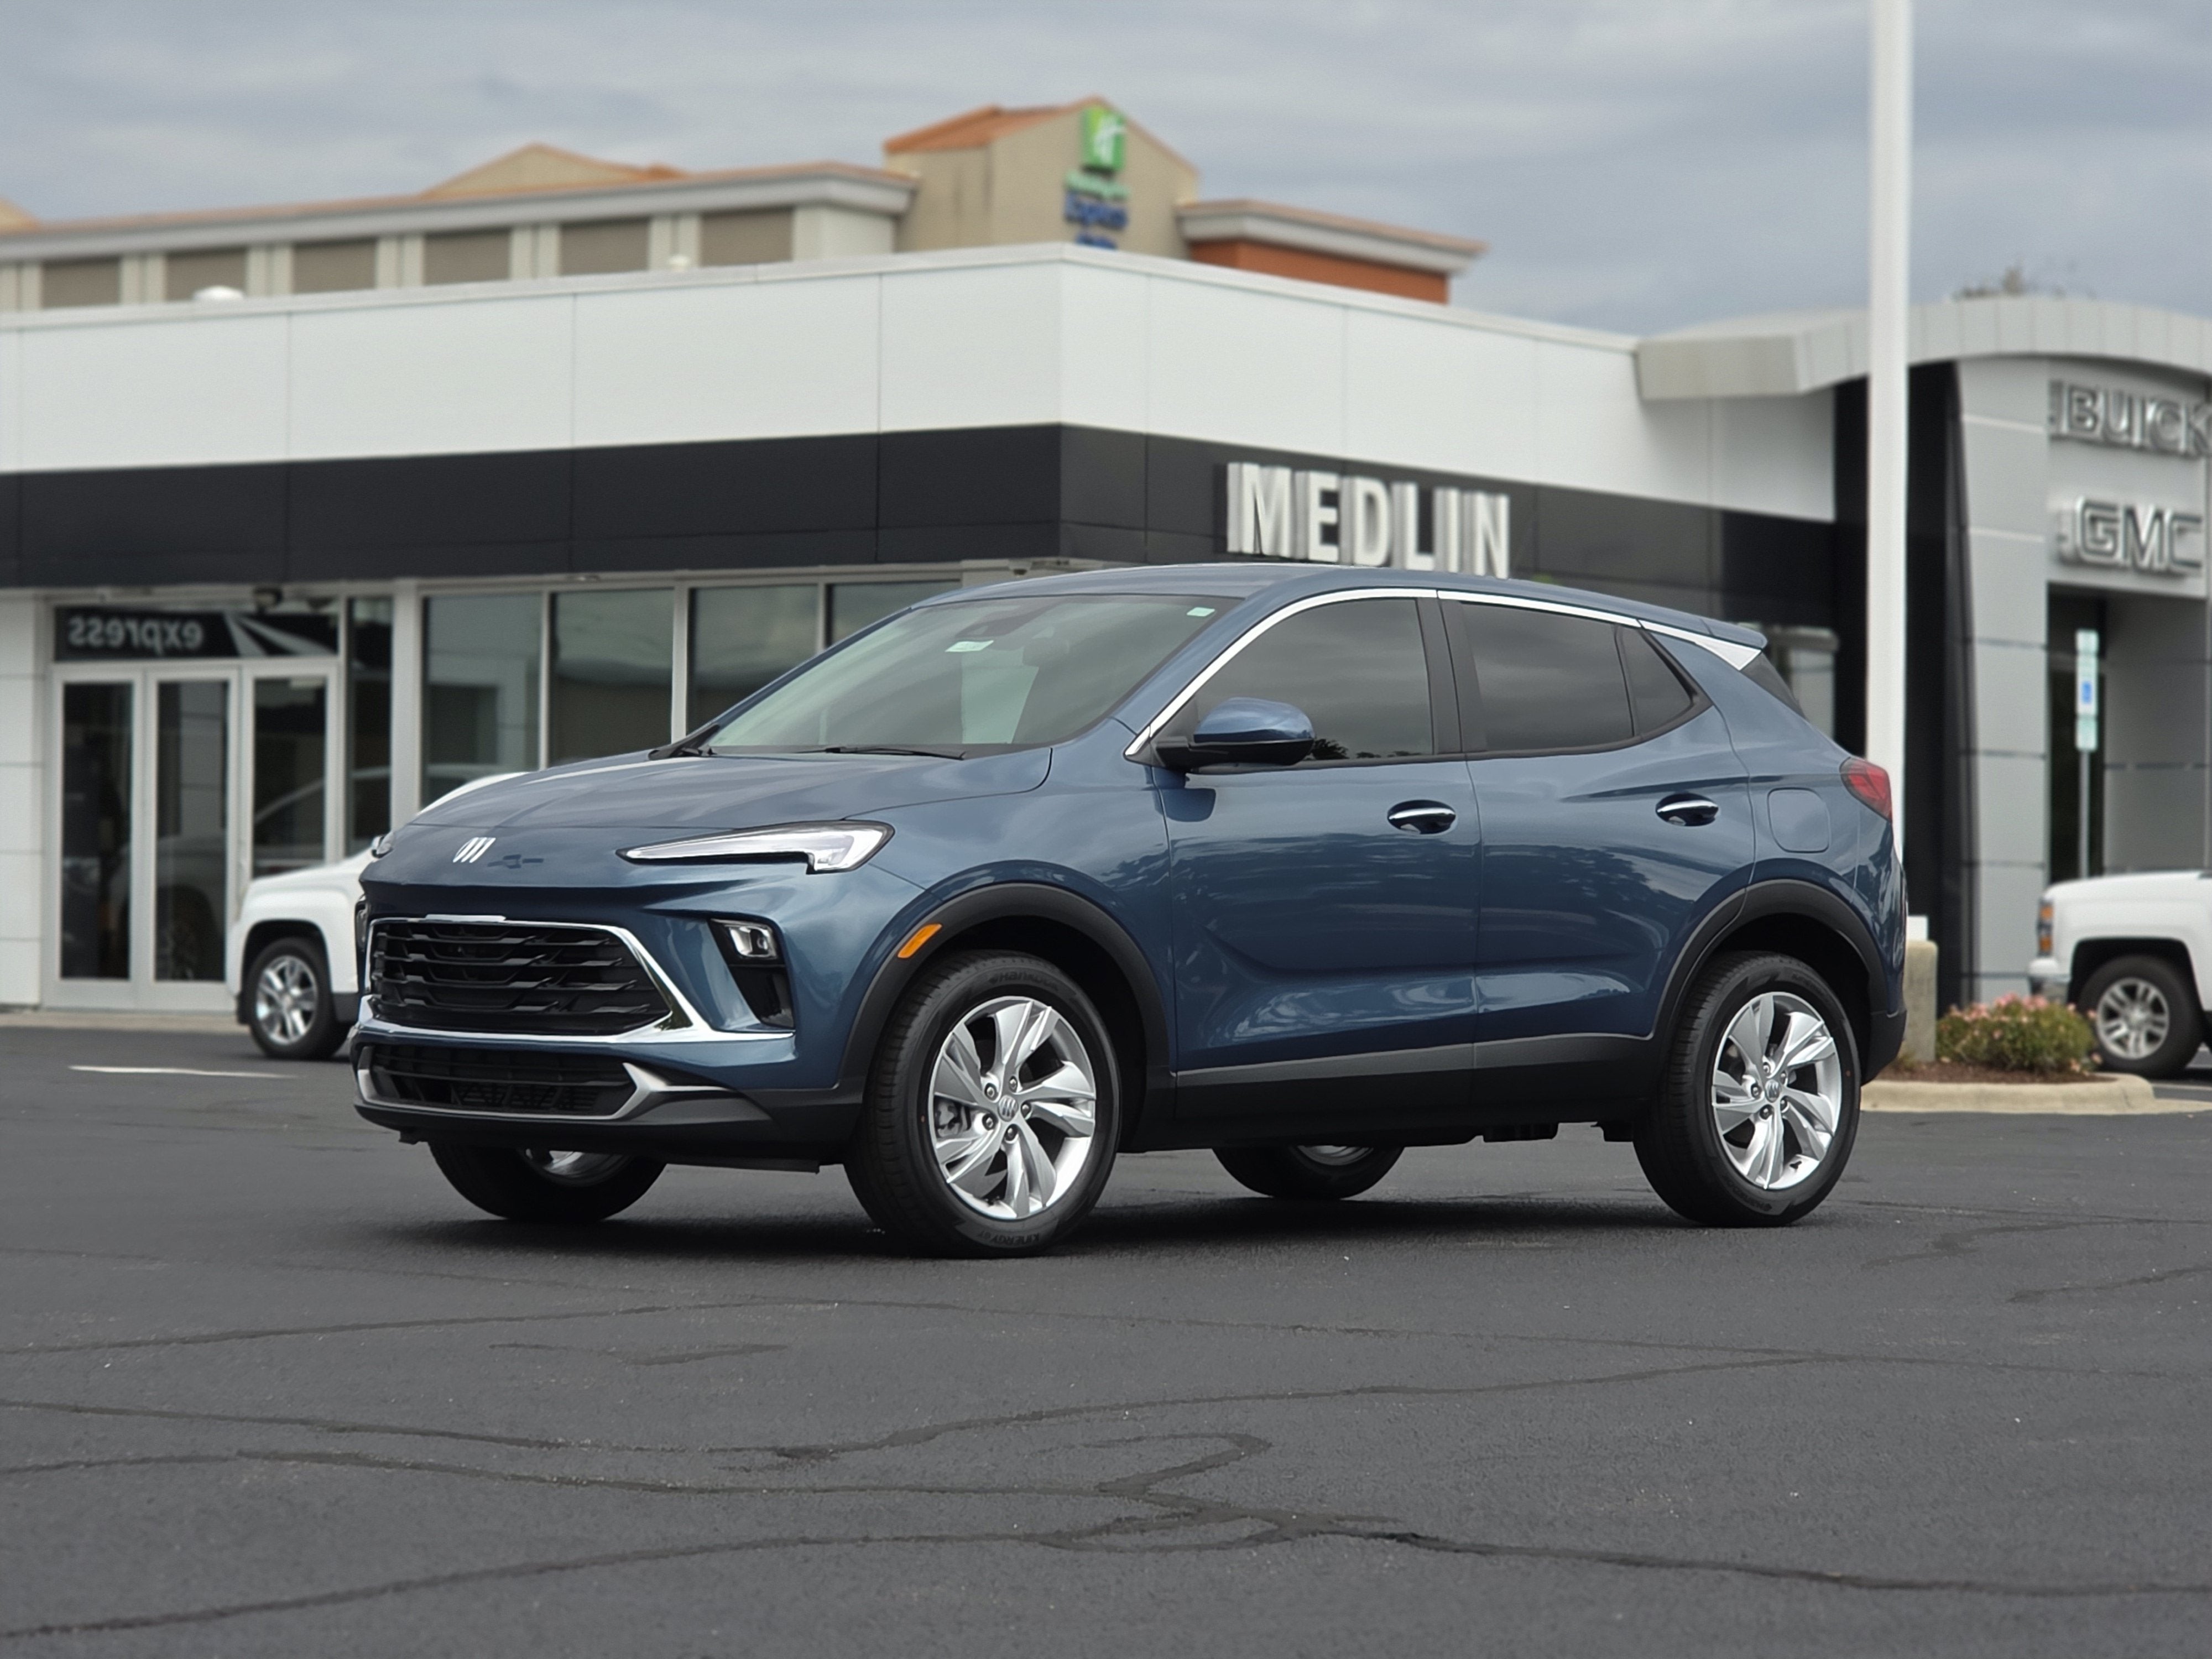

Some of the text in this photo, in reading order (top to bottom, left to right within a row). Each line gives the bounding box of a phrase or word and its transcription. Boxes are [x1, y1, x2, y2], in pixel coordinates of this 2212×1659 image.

[2063, 384, 2212, 458] BUICK
[1227, 462, 1510, 579] MEDLIN
[2075, 497, 2203, 571] GMC
